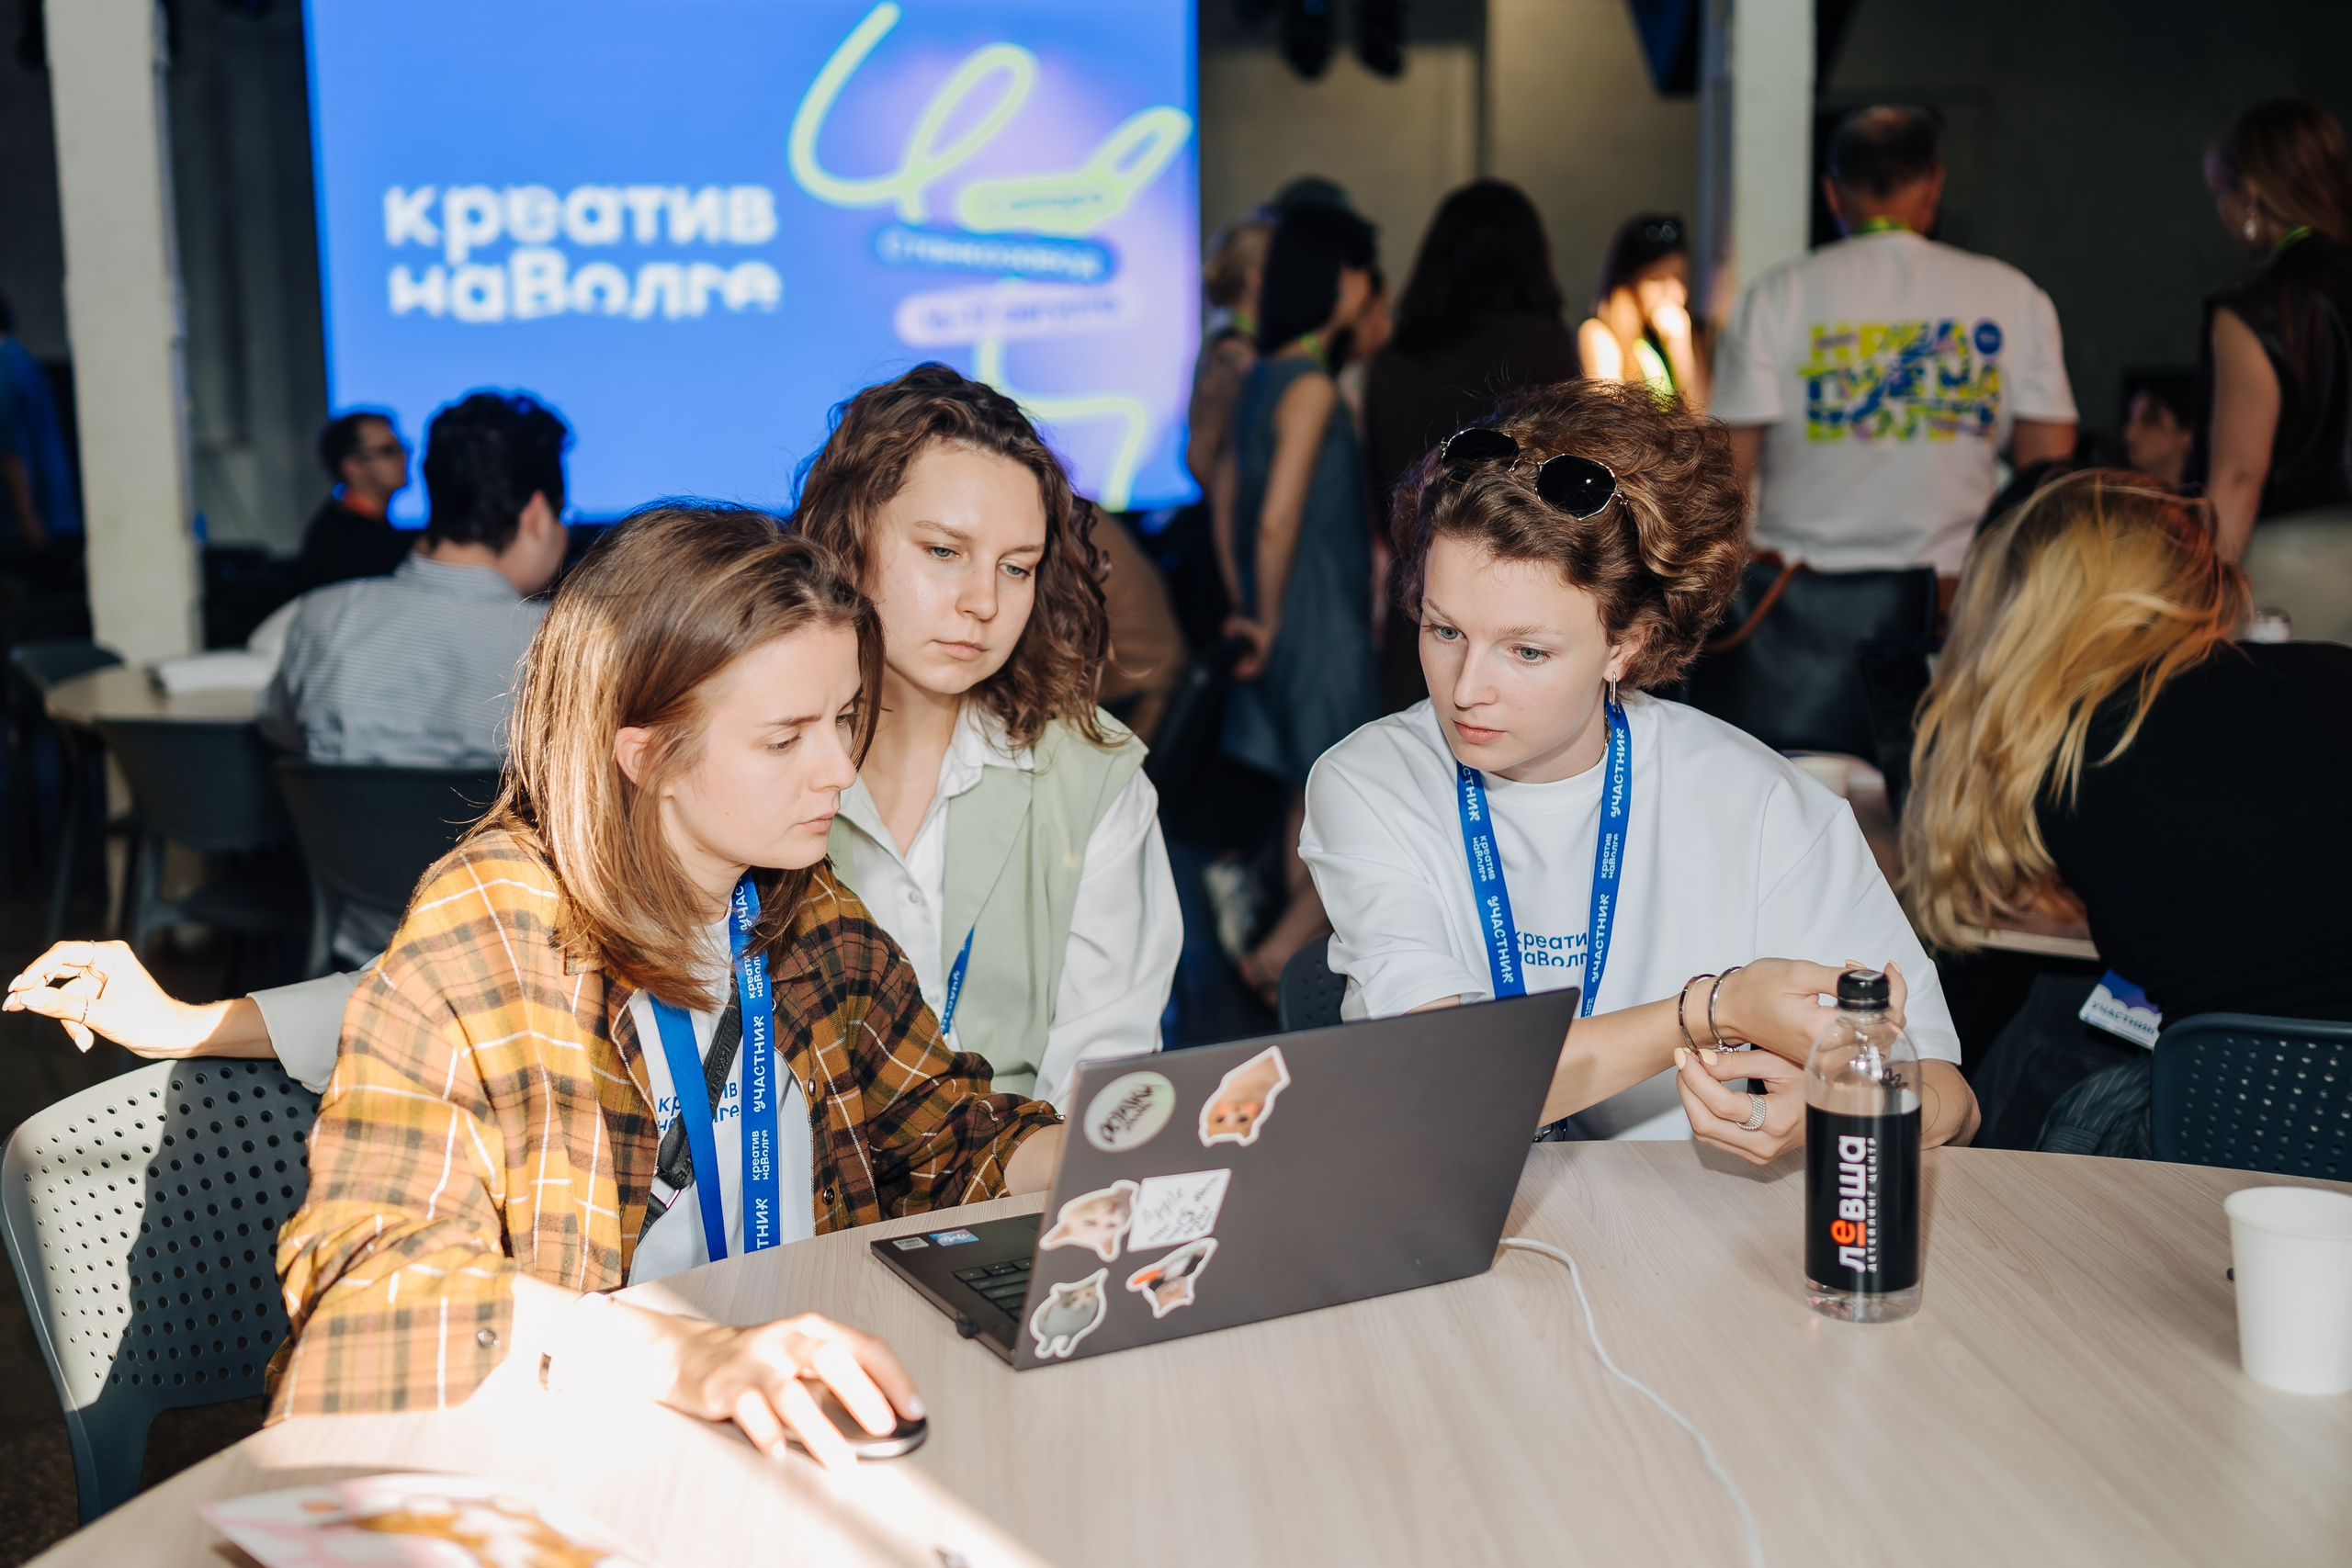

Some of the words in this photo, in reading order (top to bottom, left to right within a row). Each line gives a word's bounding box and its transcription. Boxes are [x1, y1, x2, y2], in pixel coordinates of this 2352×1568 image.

[384, 186, 777, 266] креатив
[1463, 764, 1480, 821] СТНИК
[1611, 728, 1624, 818] УЧАСТНИК
[1480, 835, 1496, 881] креатив
[1601, 833, 1612, 879] креатив
[735, 877, 752, 931] УЧАС
[1487, 896, 1514, 984] УЧАСТНИК
[1515, 931, 1588, 951] креати
[1518, 950, 1588, 968] аВолг
[1591, 894, 1610, 983] УЧАСТНИК
[742, 949, 756, 998] креати
[753, 953, 763, 998] наВол
[2091, 1000, 2155, 1036] УЧАСТНИК
[752, 1015, 766, 1113] УЧАСТНИК
[752, 1130, 761, 1181] креатив
[1867, 1137, 1879, 1185] ЦЕНТР
[756, 1198, 769, 1249] ТНИК
